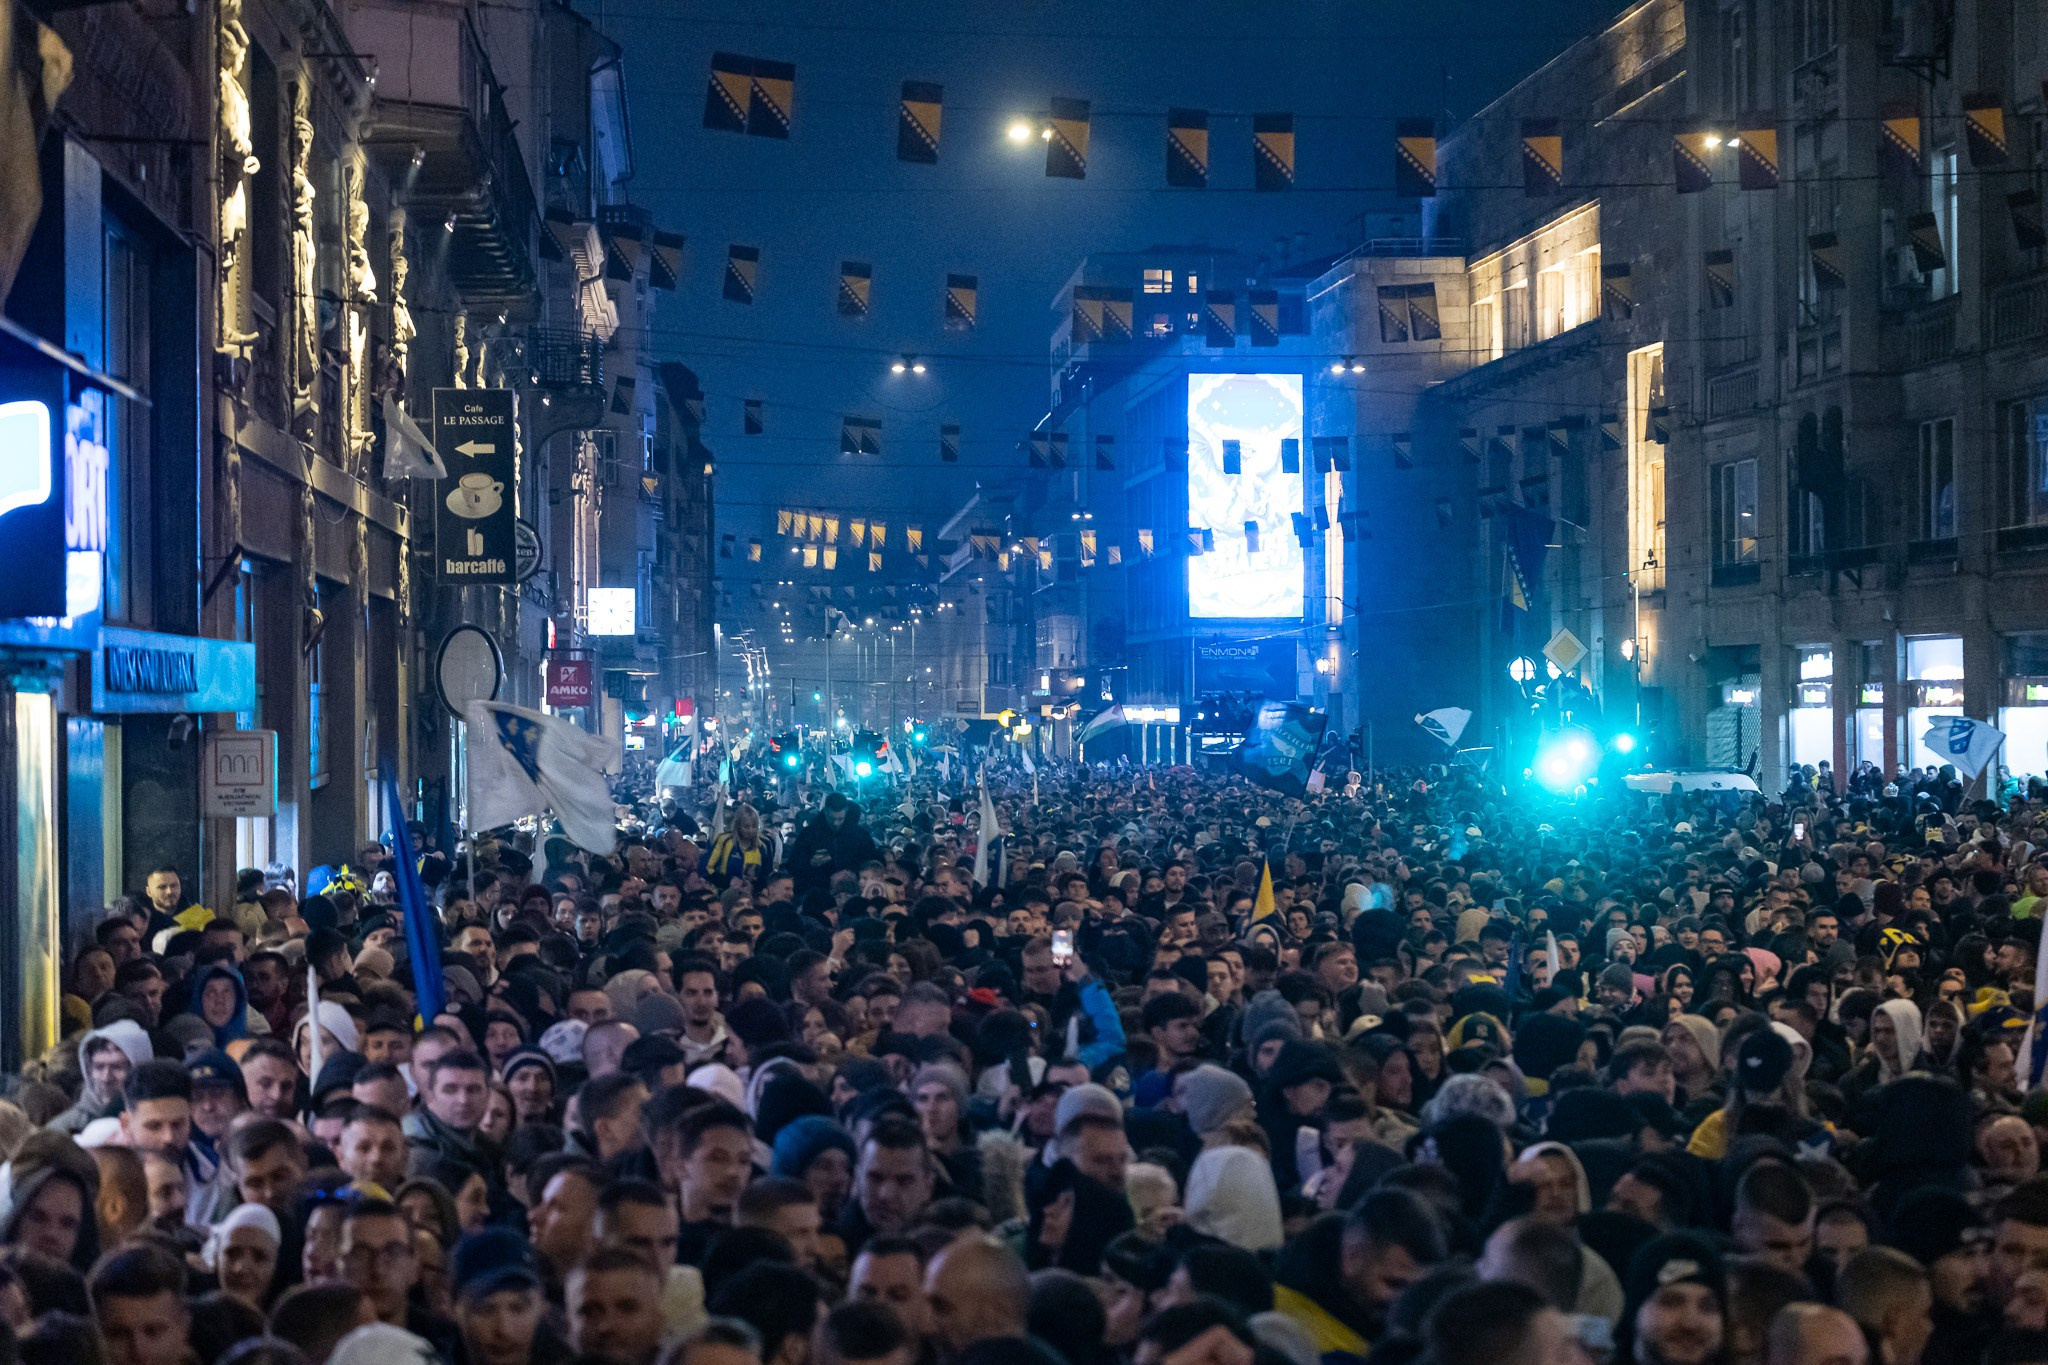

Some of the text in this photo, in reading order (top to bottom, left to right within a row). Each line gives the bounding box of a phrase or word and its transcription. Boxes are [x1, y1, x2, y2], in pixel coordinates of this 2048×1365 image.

[464, 404, 483, 413] Cafe
[444, 415, 505, 425] LE PASSAGE
[446, 558, 506, 574] barcaffé
[1201, 647, 1247, 656] ENMON
[550, 685, 588, 695] AMKO
